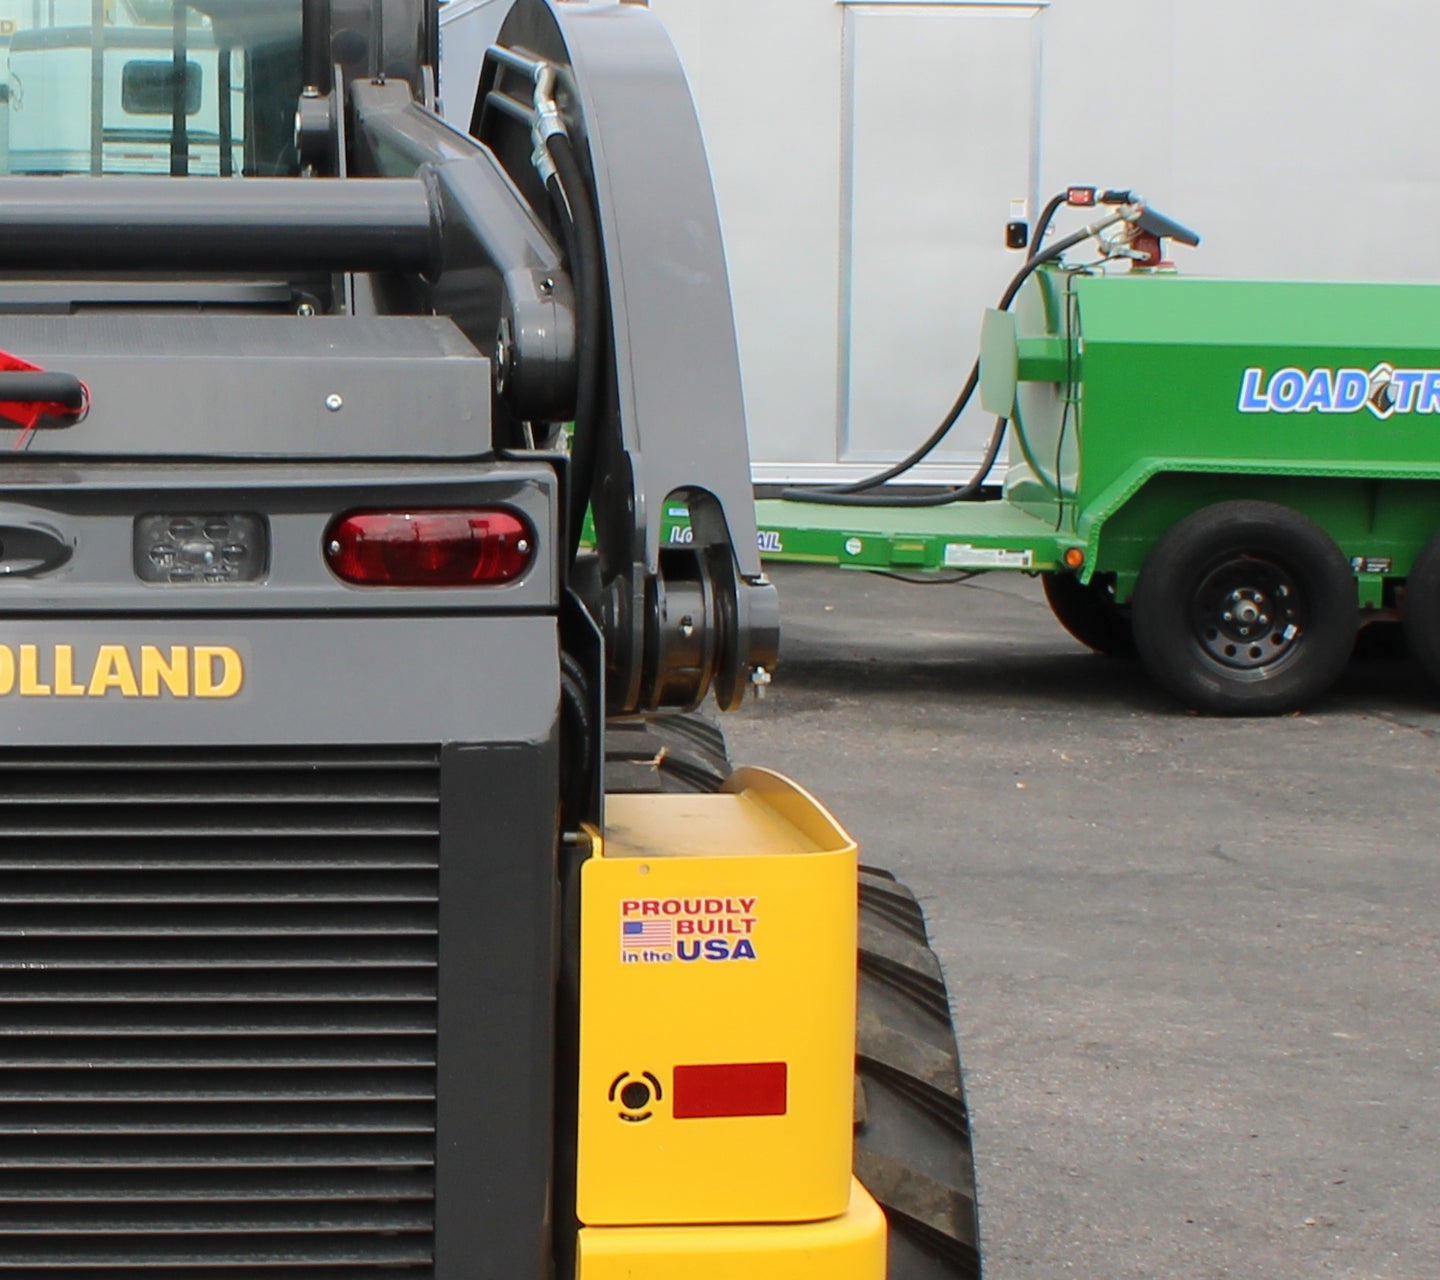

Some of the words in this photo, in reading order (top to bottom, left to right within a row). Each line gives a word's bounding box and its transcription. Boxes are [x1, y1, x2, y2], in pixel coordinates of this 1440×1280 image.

[1239, 368, 1370, 413] LOAD
[622, 898, 757, 916] PROUDLY
[676, 918, 757, 935] BUILT
[622, 951, 639, 963] in
[643, 950, 673, 962] the
[676, 939, 757, 960] USA
